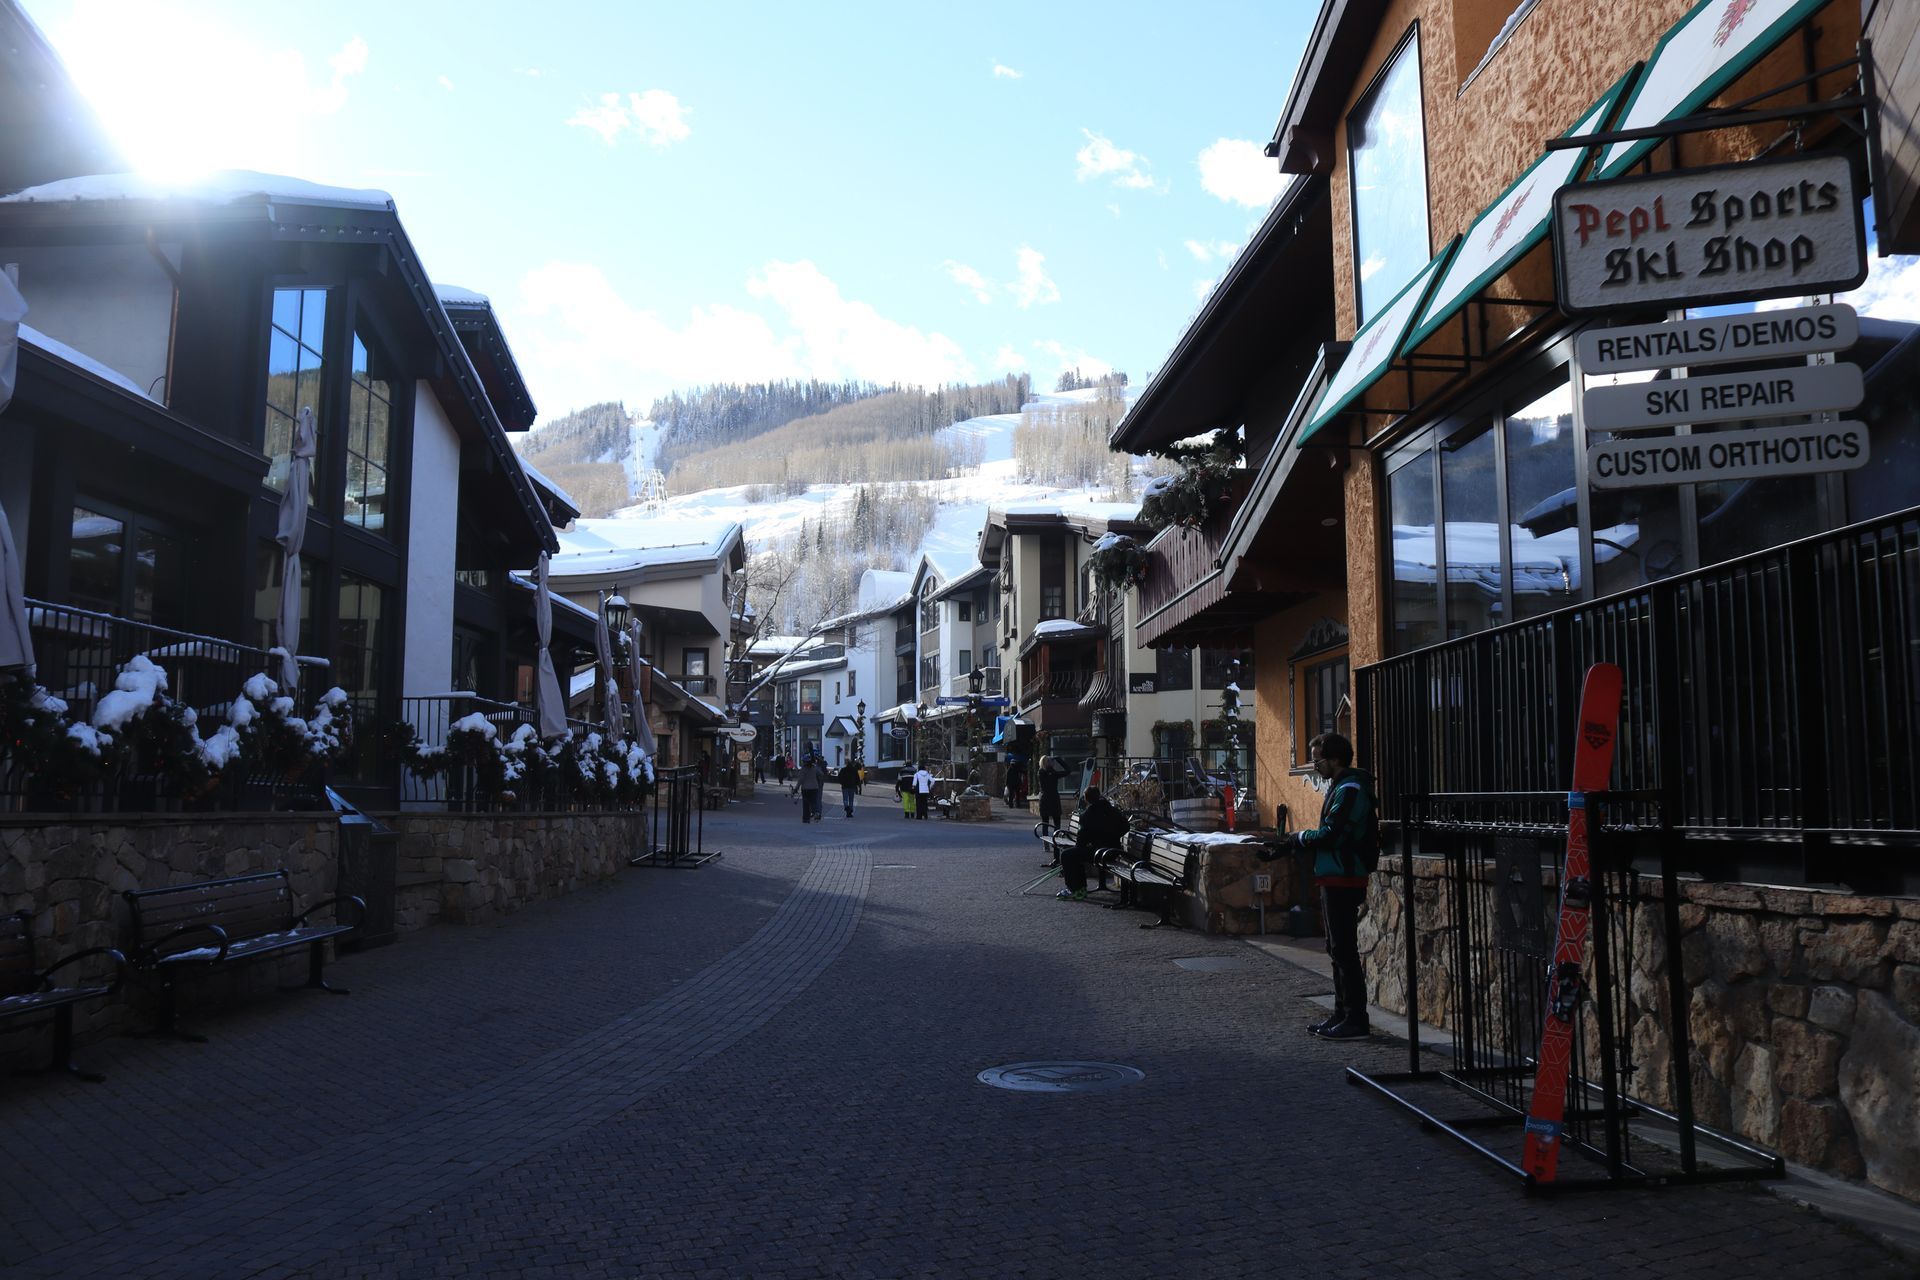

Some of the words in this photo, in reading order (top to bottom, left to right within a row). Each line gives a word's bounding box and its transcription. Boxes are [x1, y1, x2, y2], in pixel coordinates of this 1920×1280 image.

[1685, 179, 1839, 231] Sports
[1600, 241, 1684, 287] Ski
[1698, 234, 1815, 276] Shop
[1598, 314, 1837, 362] RENTALS/DEMOS
[1646, 390, 1688, 416] SKI
[1701, 379, 1795, 411] REPAIR
[1596, 446, 1702, 478] CUSTOM
[1708, 431, 1861, 470] ORTHOTICS
